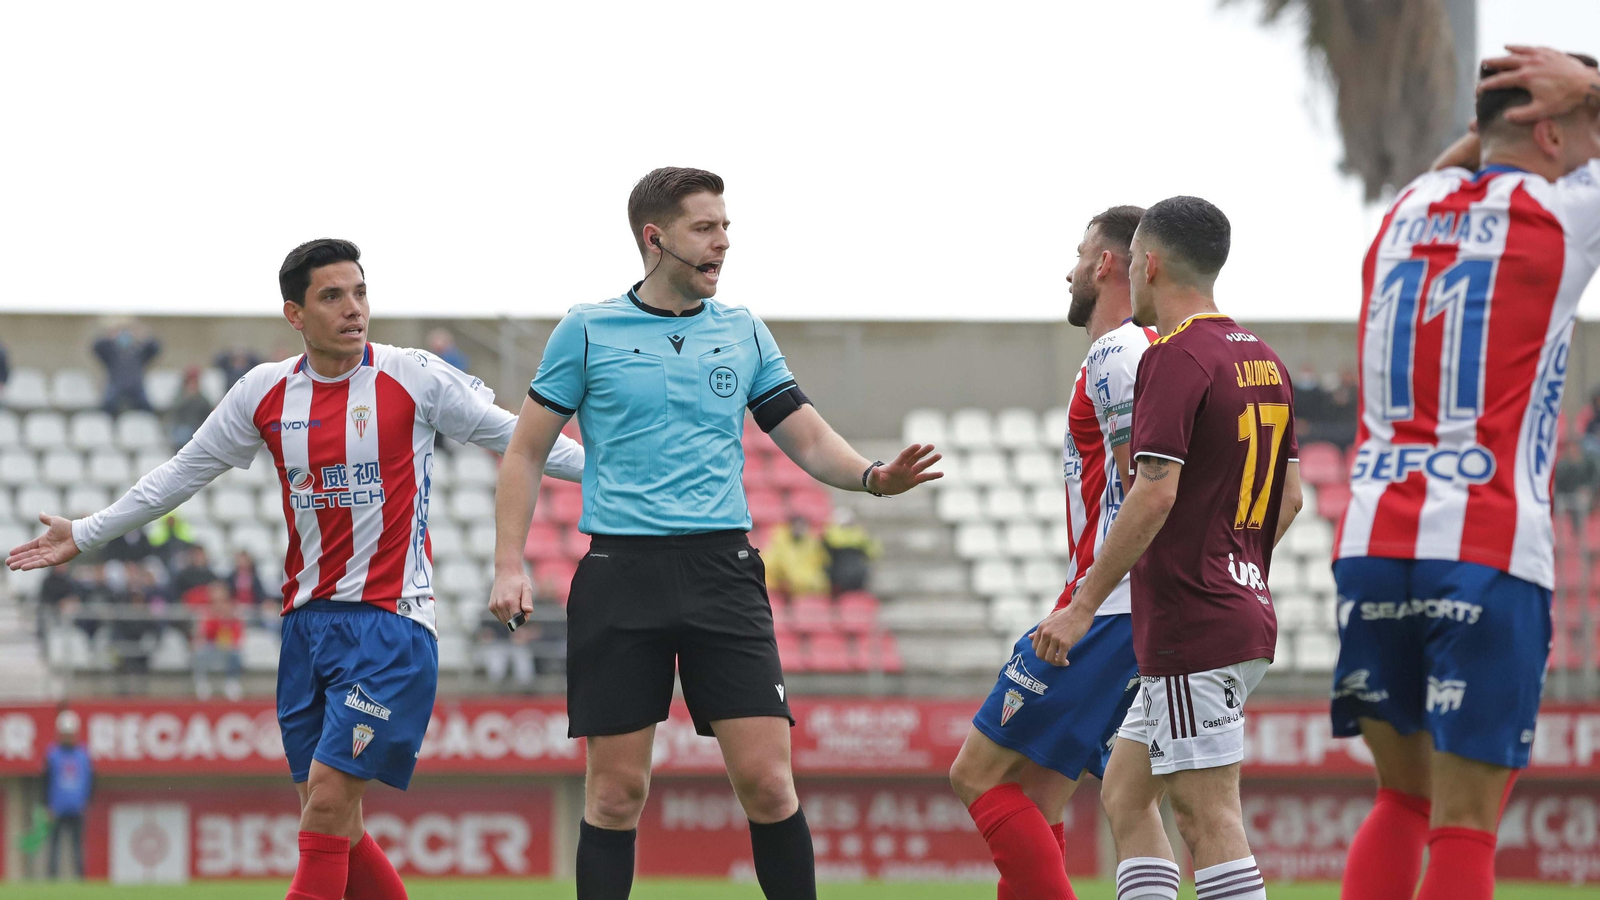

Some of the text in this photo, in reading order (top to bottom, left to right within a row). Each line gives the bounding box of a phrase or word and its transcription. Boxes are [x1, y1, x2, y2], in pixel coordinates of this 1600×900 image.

[1393, 211, 1499, 246] TOMAS
[1370, 257, 1498, 422] 11
[270, 419, 321, 432] GIVOVA
[321, 461, 383, 489] 威视
[1234, 402, 1290, 531] 17
[196, 814, 532, 877] BESCCER
